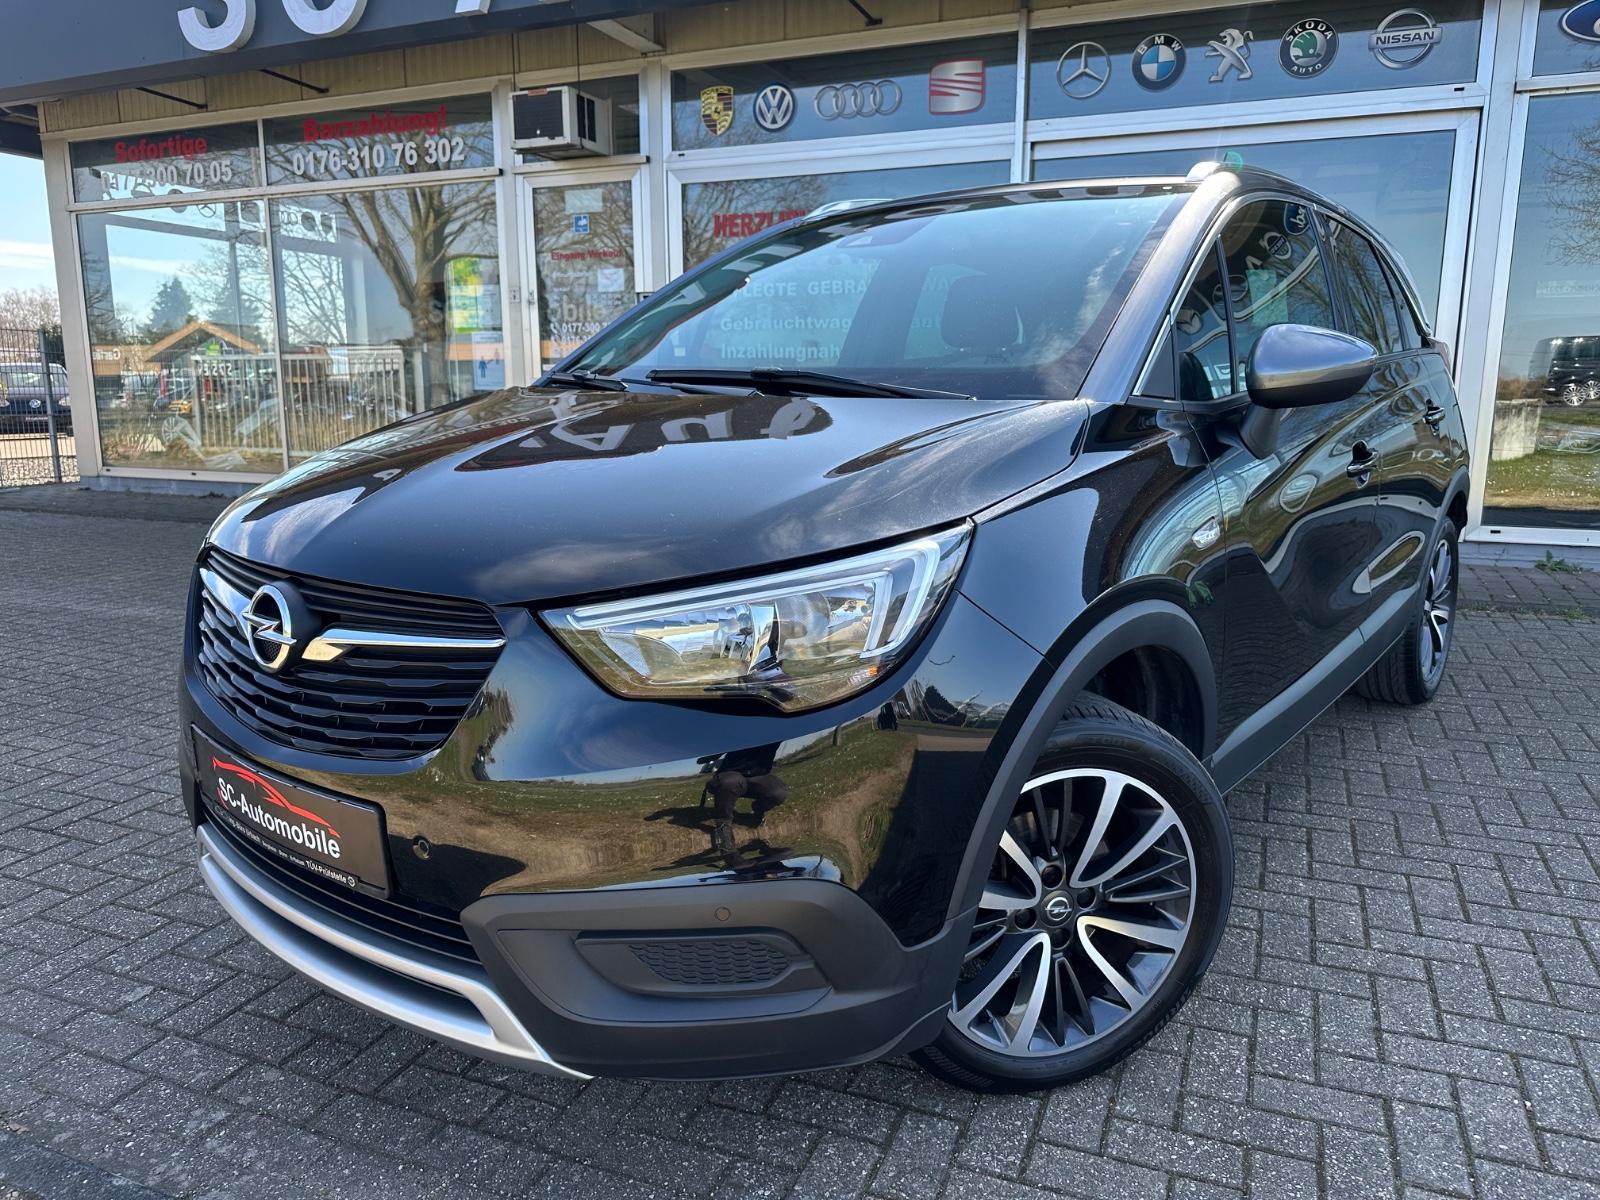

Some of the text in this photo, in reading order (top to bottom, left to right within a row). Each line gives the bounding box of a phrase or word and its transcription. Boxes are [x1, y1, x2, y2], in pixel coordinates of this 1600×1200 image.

[1285, 21, 1333, 41] SKODA
[1375, 31, 1435, 46] NISSAN
[1137, 35, 1182, 55] BMW
[1291, 63, 1322, 73] AUTO
[757, 86, 792, 129] VW
[114, 102, 447, 163] Sofortige Barzahlung!
[292, 136, 465, 176] 0176-310 76 302
[184, 162, 205, 185] 70
[209, 160, 233, 183] 05
[218, 777, 341, 859] SC-Automobile
